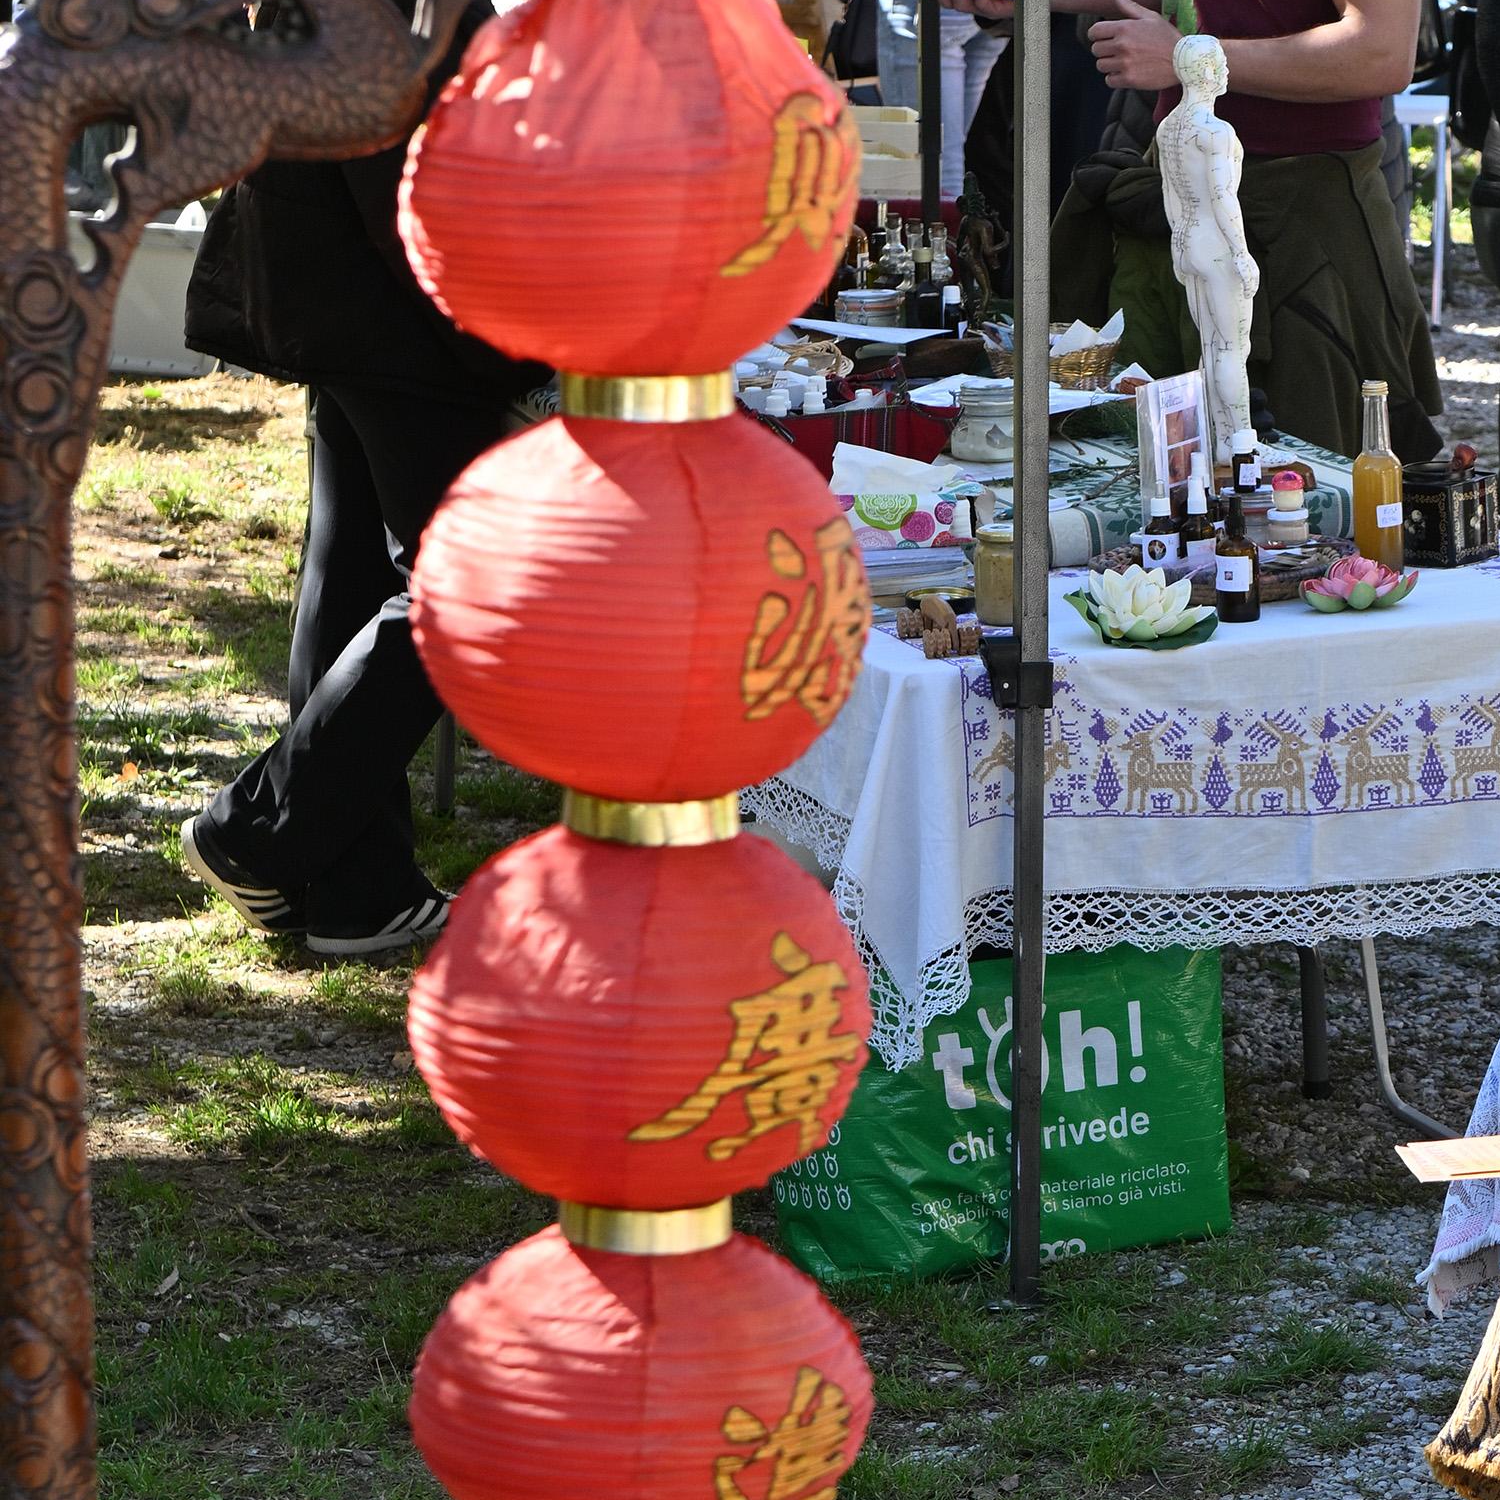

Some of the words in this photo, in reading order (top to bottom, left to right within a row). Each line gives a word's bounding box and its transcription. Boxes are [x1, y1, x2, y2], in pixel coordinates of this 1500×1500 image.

[947, 1127, 996, 1165] chi
[1043, 1107, 1150, 1150] rivede
[911, 1197, 952, 1217] Sono
[958, 1190, 997, 1206] fatta
[1121, 1161, 1190, 1184] riciclato,
[920, 1206, 1010, 1236] probabilme
[1043, 1198, 1057, 1213] ci
[1062, 1192, 1114, 1212] siamo
[1118, 1185, 1144, 1206] già
[1148, 1178, 1187, 1198] visti.
